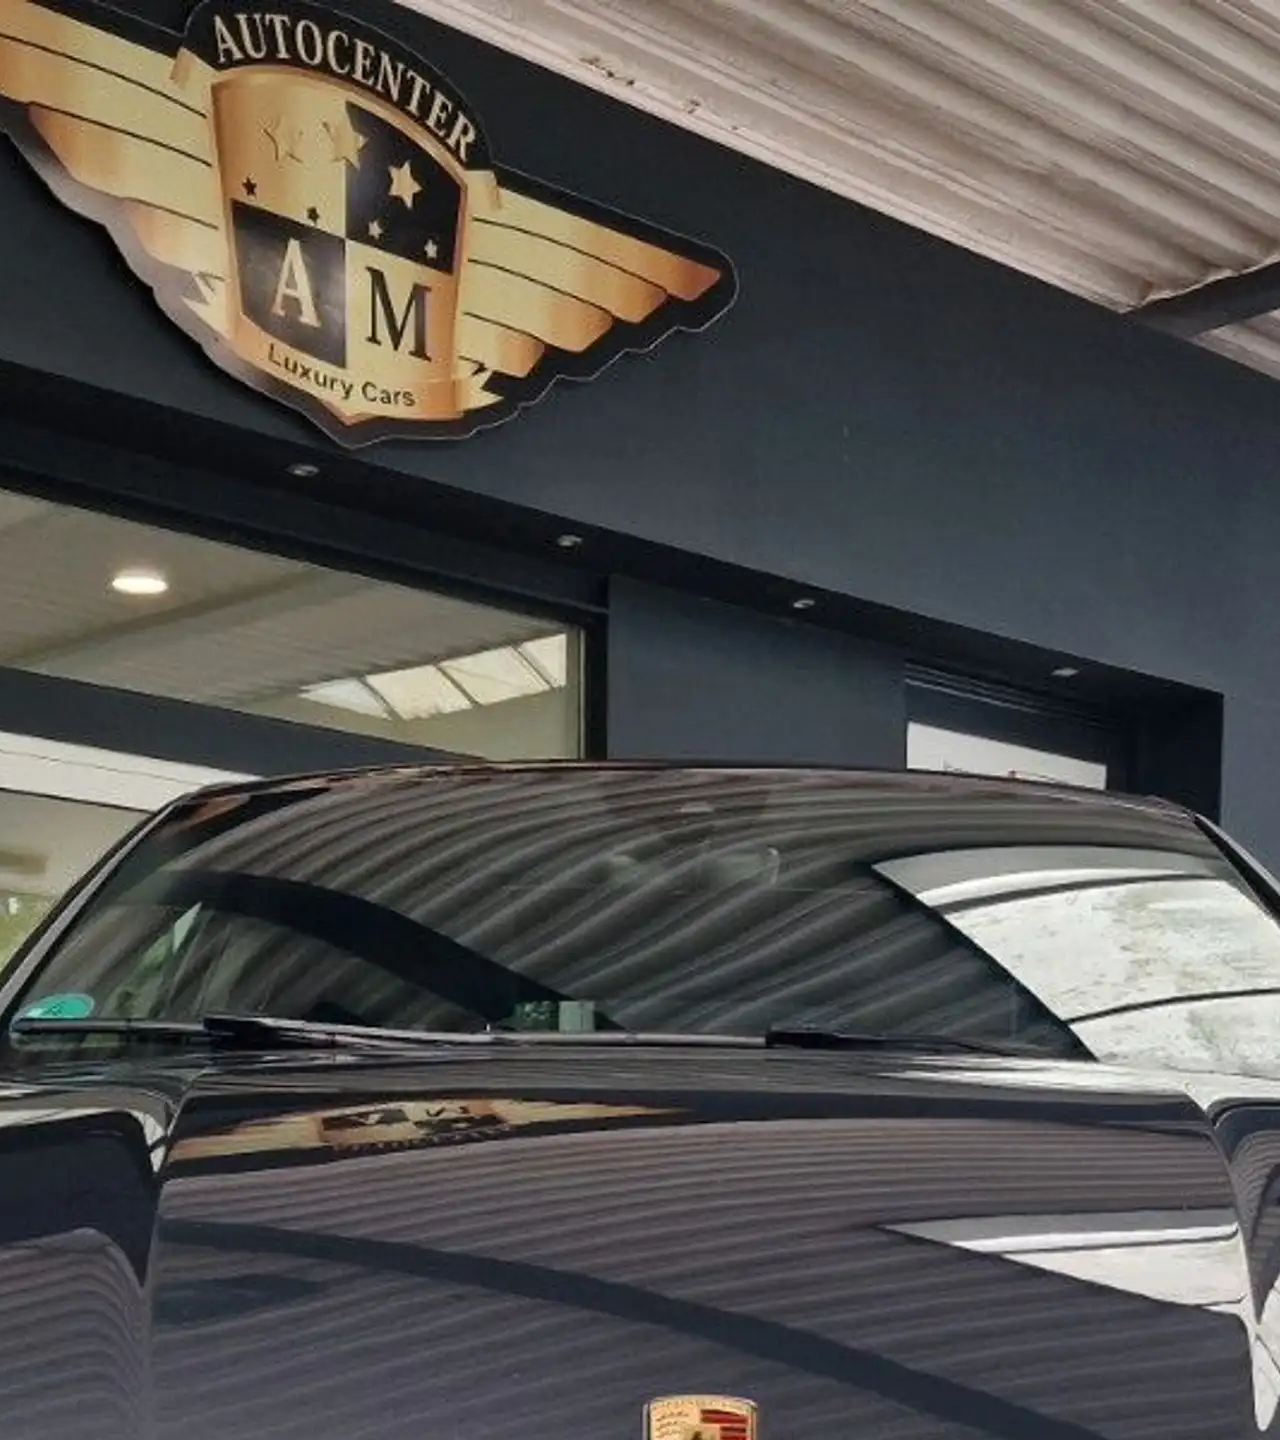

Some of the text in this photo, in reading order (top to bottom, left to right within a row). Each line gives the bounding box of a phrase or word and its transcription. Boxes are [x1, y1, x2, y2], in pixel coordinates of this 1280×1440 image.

[213, 13, 476, 162] AUTOCENTER
[271, 236, 432, 362] A M
[267, 342, 417, 407] Luxury Cars
